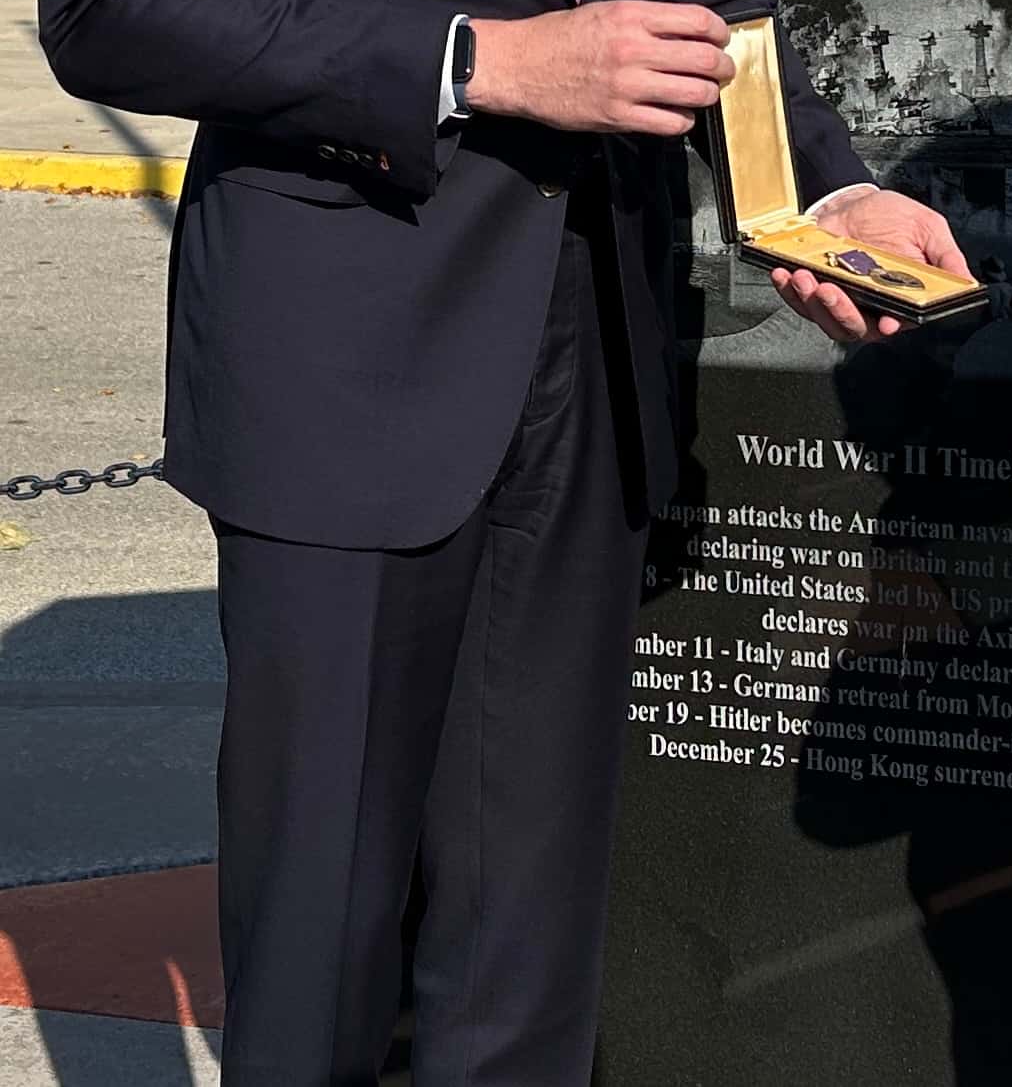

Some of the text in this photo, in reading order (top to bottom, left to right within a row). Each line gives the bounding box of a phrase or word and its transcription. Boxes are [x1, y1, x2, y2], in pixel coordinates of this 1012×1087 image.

[736, 434, 824, 468] World
[832, 440, 895, 473] War
[903, 444, 928, 475] II
[657, 500, 721, 528] Japan
[727, 504, 803, 531] attacks
[808, 508, 842, 533] the
[847, 511, 955, 539] American
[686, 534, 785, 570] declaring
[790, 547, 833, 567] war
[837, 549, 864, 568] on
[870, 546, 947, 577] Britain
[954, 557, 994, 580] and
[645, 565, 657, 587] 8
[677, 567, 719, 592] The
[724, 569, 795, 598] United
[877, 583, 909, 607] led
[915, 585, 945, 613] by
[951, 587, 982, 612] US
[761, 608, 849, 636] declares
[855, 620, 896, 639] war
[903, 622, 929, 643] on
[935, 622, 970, 647] the
[634, 632, 688, 658] mber
[693, 635, 714, 660] 11
[735, 639, 785, 671] Italy
[790, 646, 831, 670] and
[836, 648, 938, 684] Germany
[631, 666, 684, 691] mber
[689, 669, 714, 694] 13
[733, 673, 832, 705] Germans
[838, 684, 911, 711] retreat
[917, 688, 970, 715] from
[665, 701, 689, 726] 19
[709, 704, 772, 733] Hitler
[777, 710, 867, 741] becomes
[649, 733, 755, 765] December
[760, 743, 785, 768] 25
[806, 748, 863, 781] Hong
[870, 754, 929, 786] Kong
